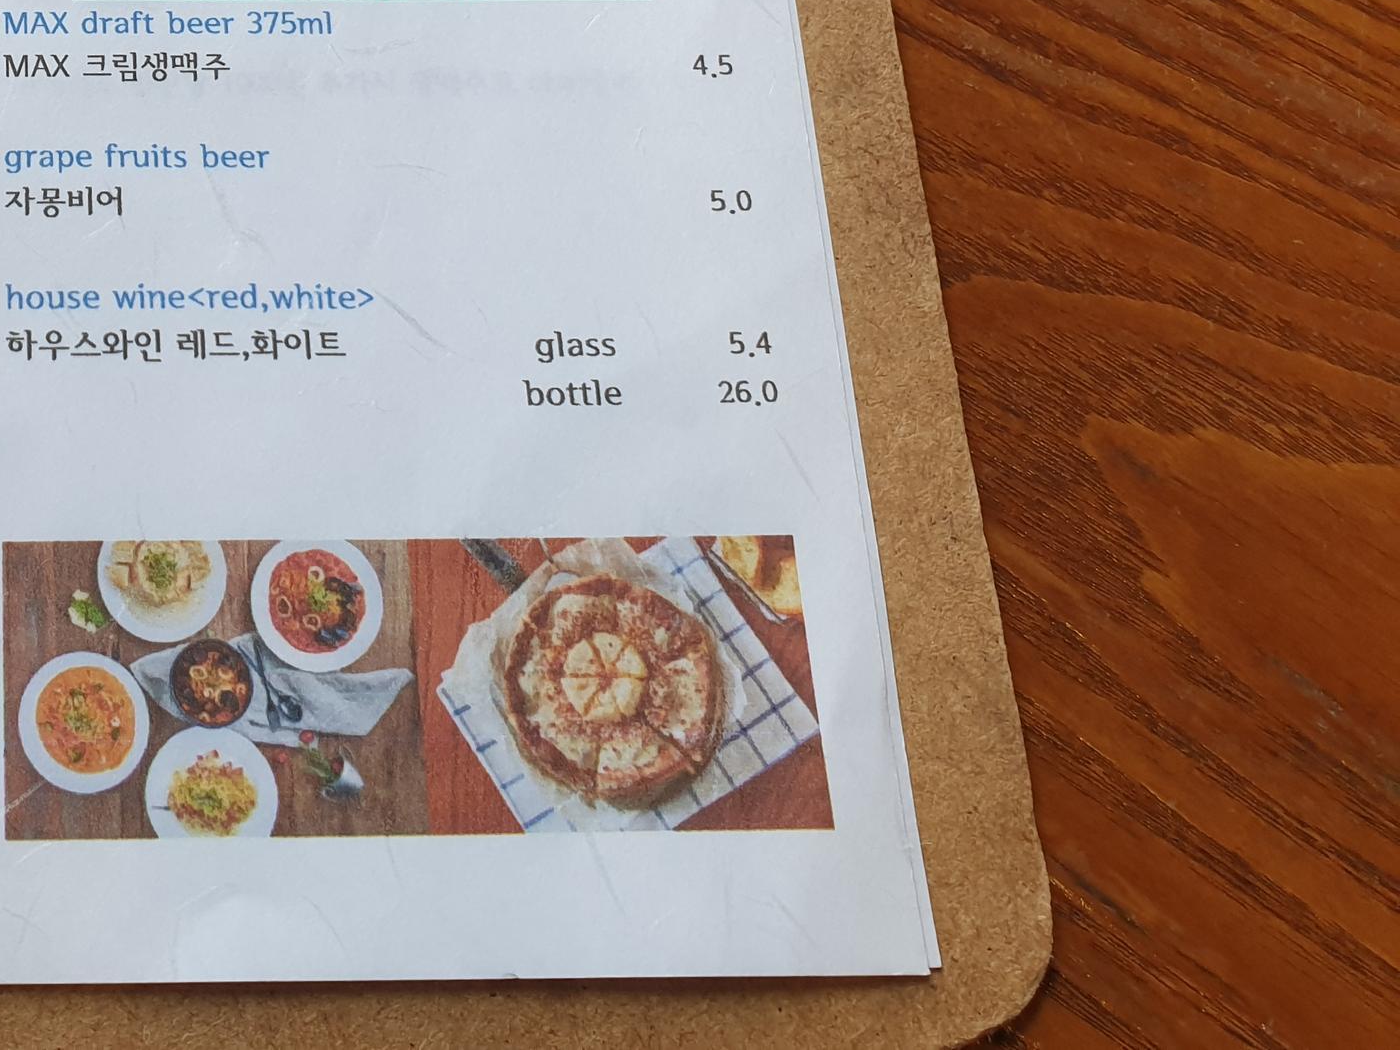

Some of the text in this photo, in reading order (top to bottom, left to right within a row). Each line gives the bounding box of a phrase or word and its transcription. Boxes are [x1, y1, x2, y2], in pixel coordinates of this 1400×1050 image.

[2, 10, 332, 35] MAX draft beer 375ml
[2, 51, 231, 83] MAX 크림생맥주
[692, 54, 734, 79] 4.5
[3, 142, 270, 174] grape fruits beer
[4, 185, 123, 219] 자몽비어
[710, 189, 753, 215] 5.0
[5, 283, 101, 311] house
[5, 328, 162, 363] 하우스와인
[534, 330, 617, 364] glass
[729, 331, 773, 358] 5.4
[521, 378, 623, 407] bottle
[717, 379, 779, 407] 26.0
